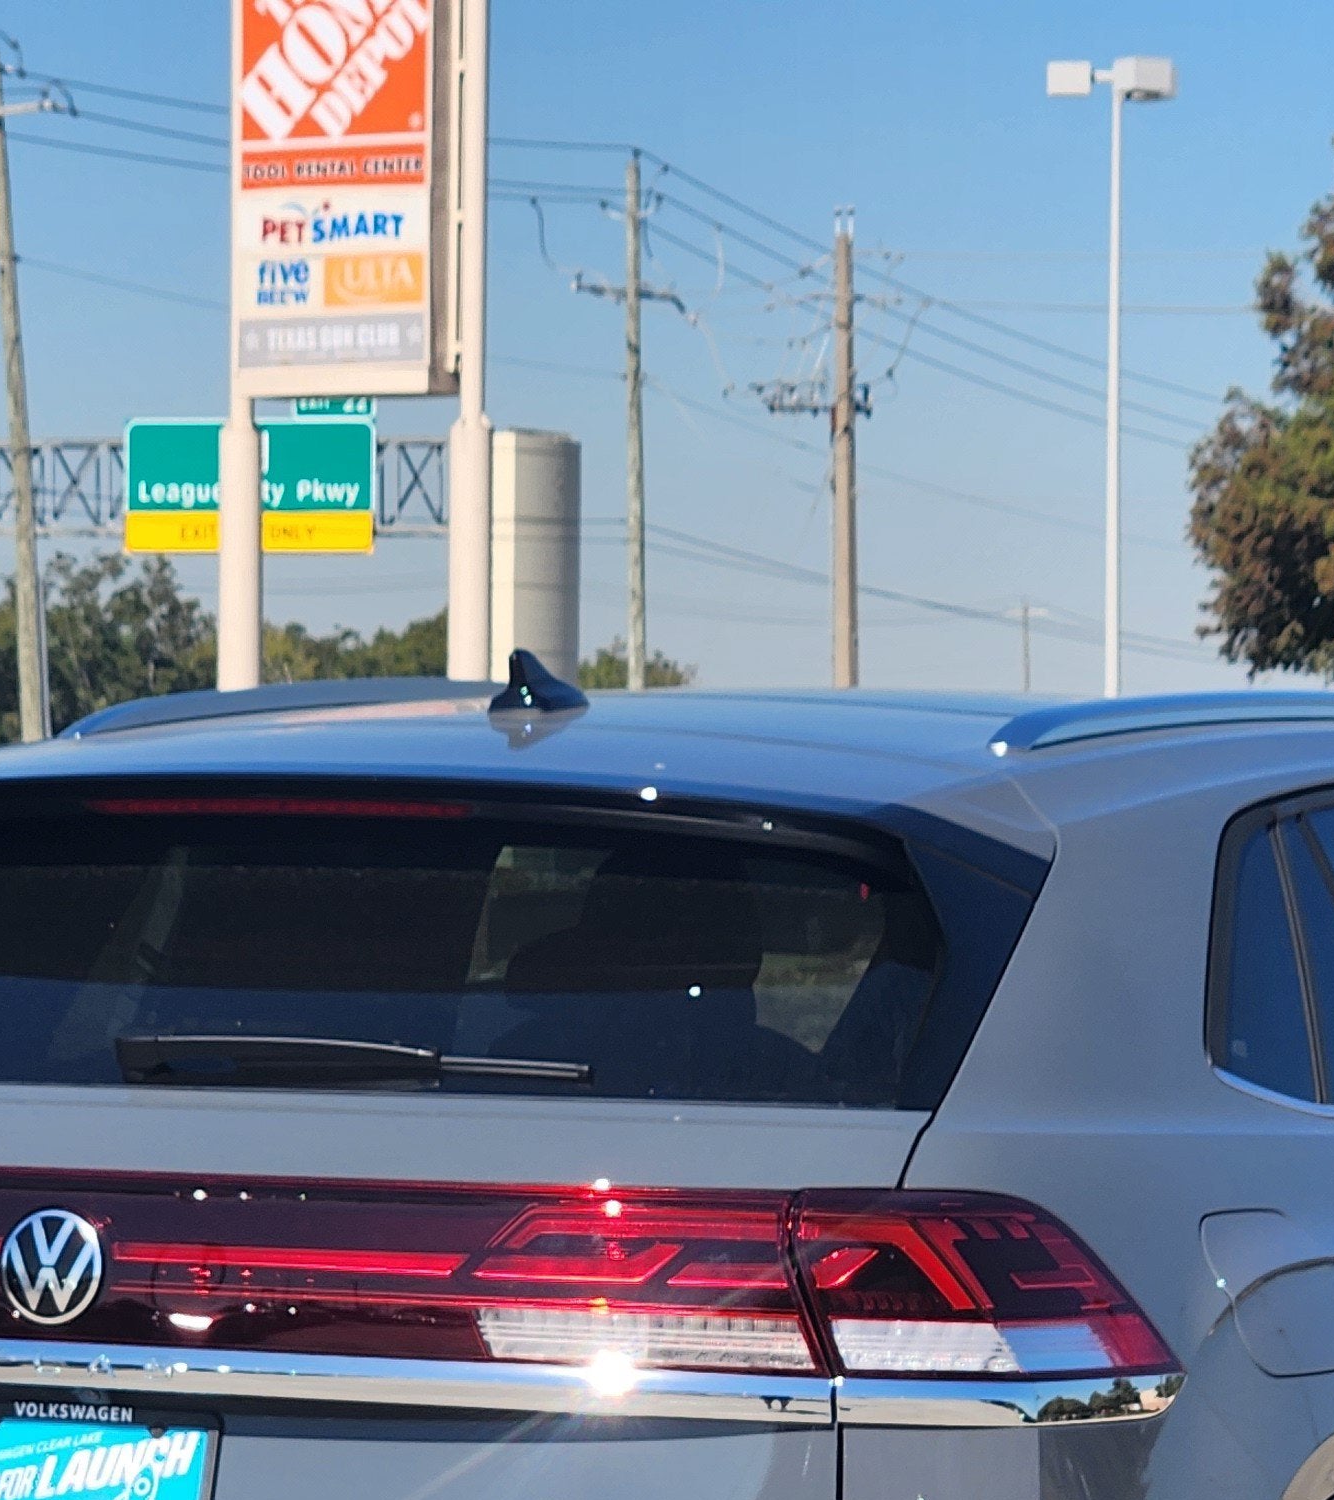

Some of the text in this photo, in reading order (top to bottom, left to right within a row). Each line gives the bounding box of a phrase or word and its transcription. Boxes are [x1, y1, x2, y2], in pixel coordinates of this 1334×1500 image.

[362, 155, 424, 177] CENTER
[342, 255, 416, 290] ULTA
[296, 477, 361, 508] Pkwy
[13, 1401, 134, 1423] VOLKSWAGEN
[33, 1430, 202, 1500] LAUNCH
